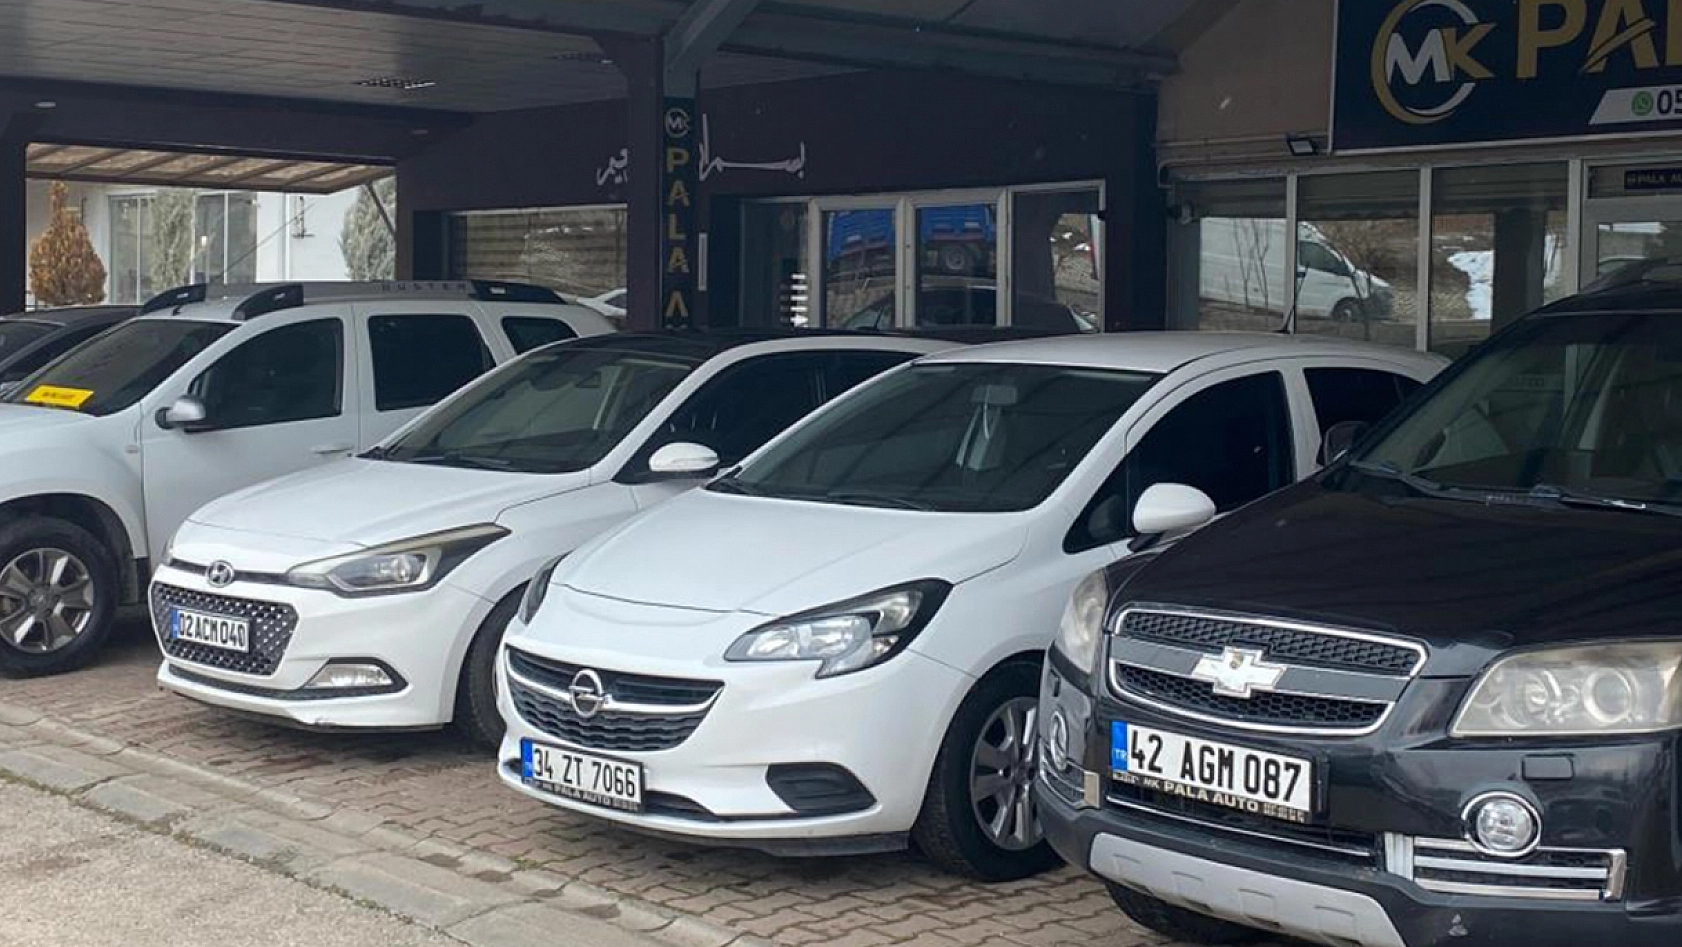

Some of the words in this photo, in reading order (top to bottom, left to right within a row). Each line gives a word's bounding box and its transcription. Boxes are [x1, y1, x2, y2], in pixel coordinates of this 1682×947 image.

[1386, 22, 1498, 85] MK
[533, 748, 553, 780] 34
[562, 754, 583, 787] ZT
[592, 761, 635, 797] 7066
[1130, 729, 1164, 774] 42
[1180, 740, 1235, 790] AGM
[1243, 754, 1302, 803] 087
[1163, 780, 1209, 801] PALA
[1212, 793, 1259, 811] AUTO
